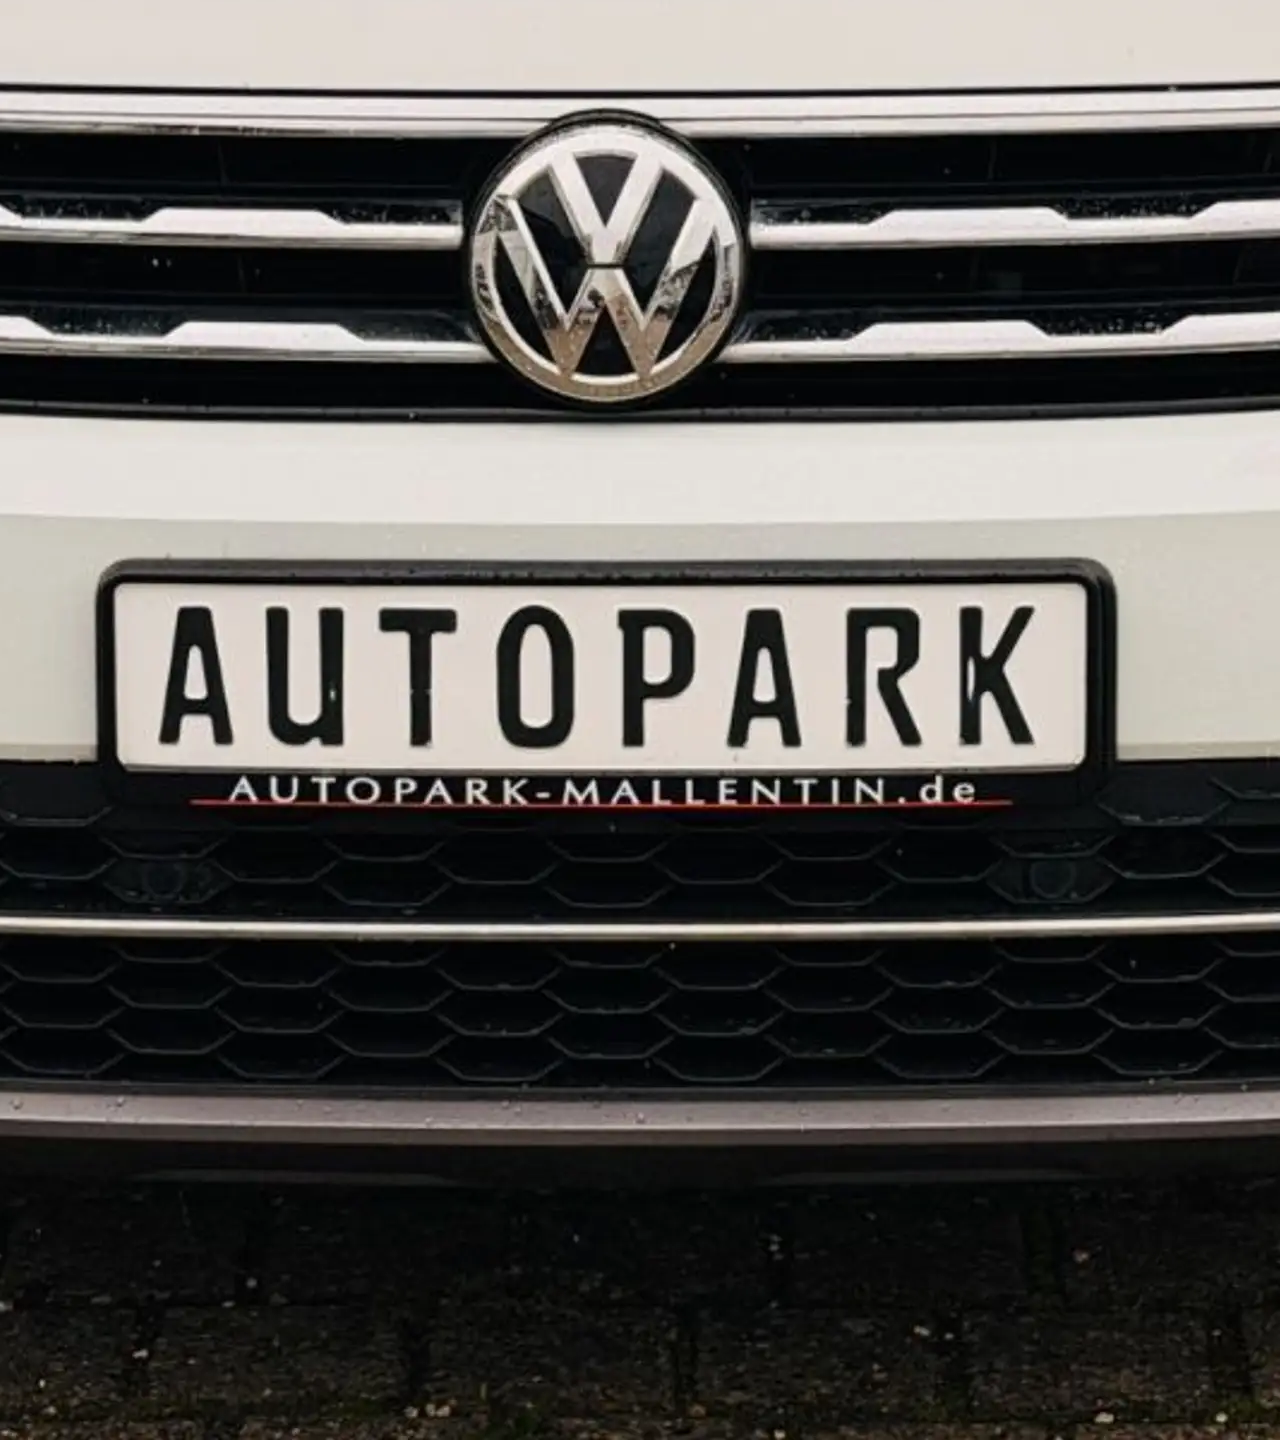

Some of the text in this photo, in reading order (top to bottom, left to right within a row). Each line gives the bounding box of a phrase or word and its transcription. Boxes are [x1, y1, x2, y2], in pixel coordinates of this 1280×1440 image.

[473, 122, 742, 401] VW
[157, 604, 1037, 749] AUTOPARK
[228, 774, 977, 806] AUTOPARK-MALLENTIN.de
